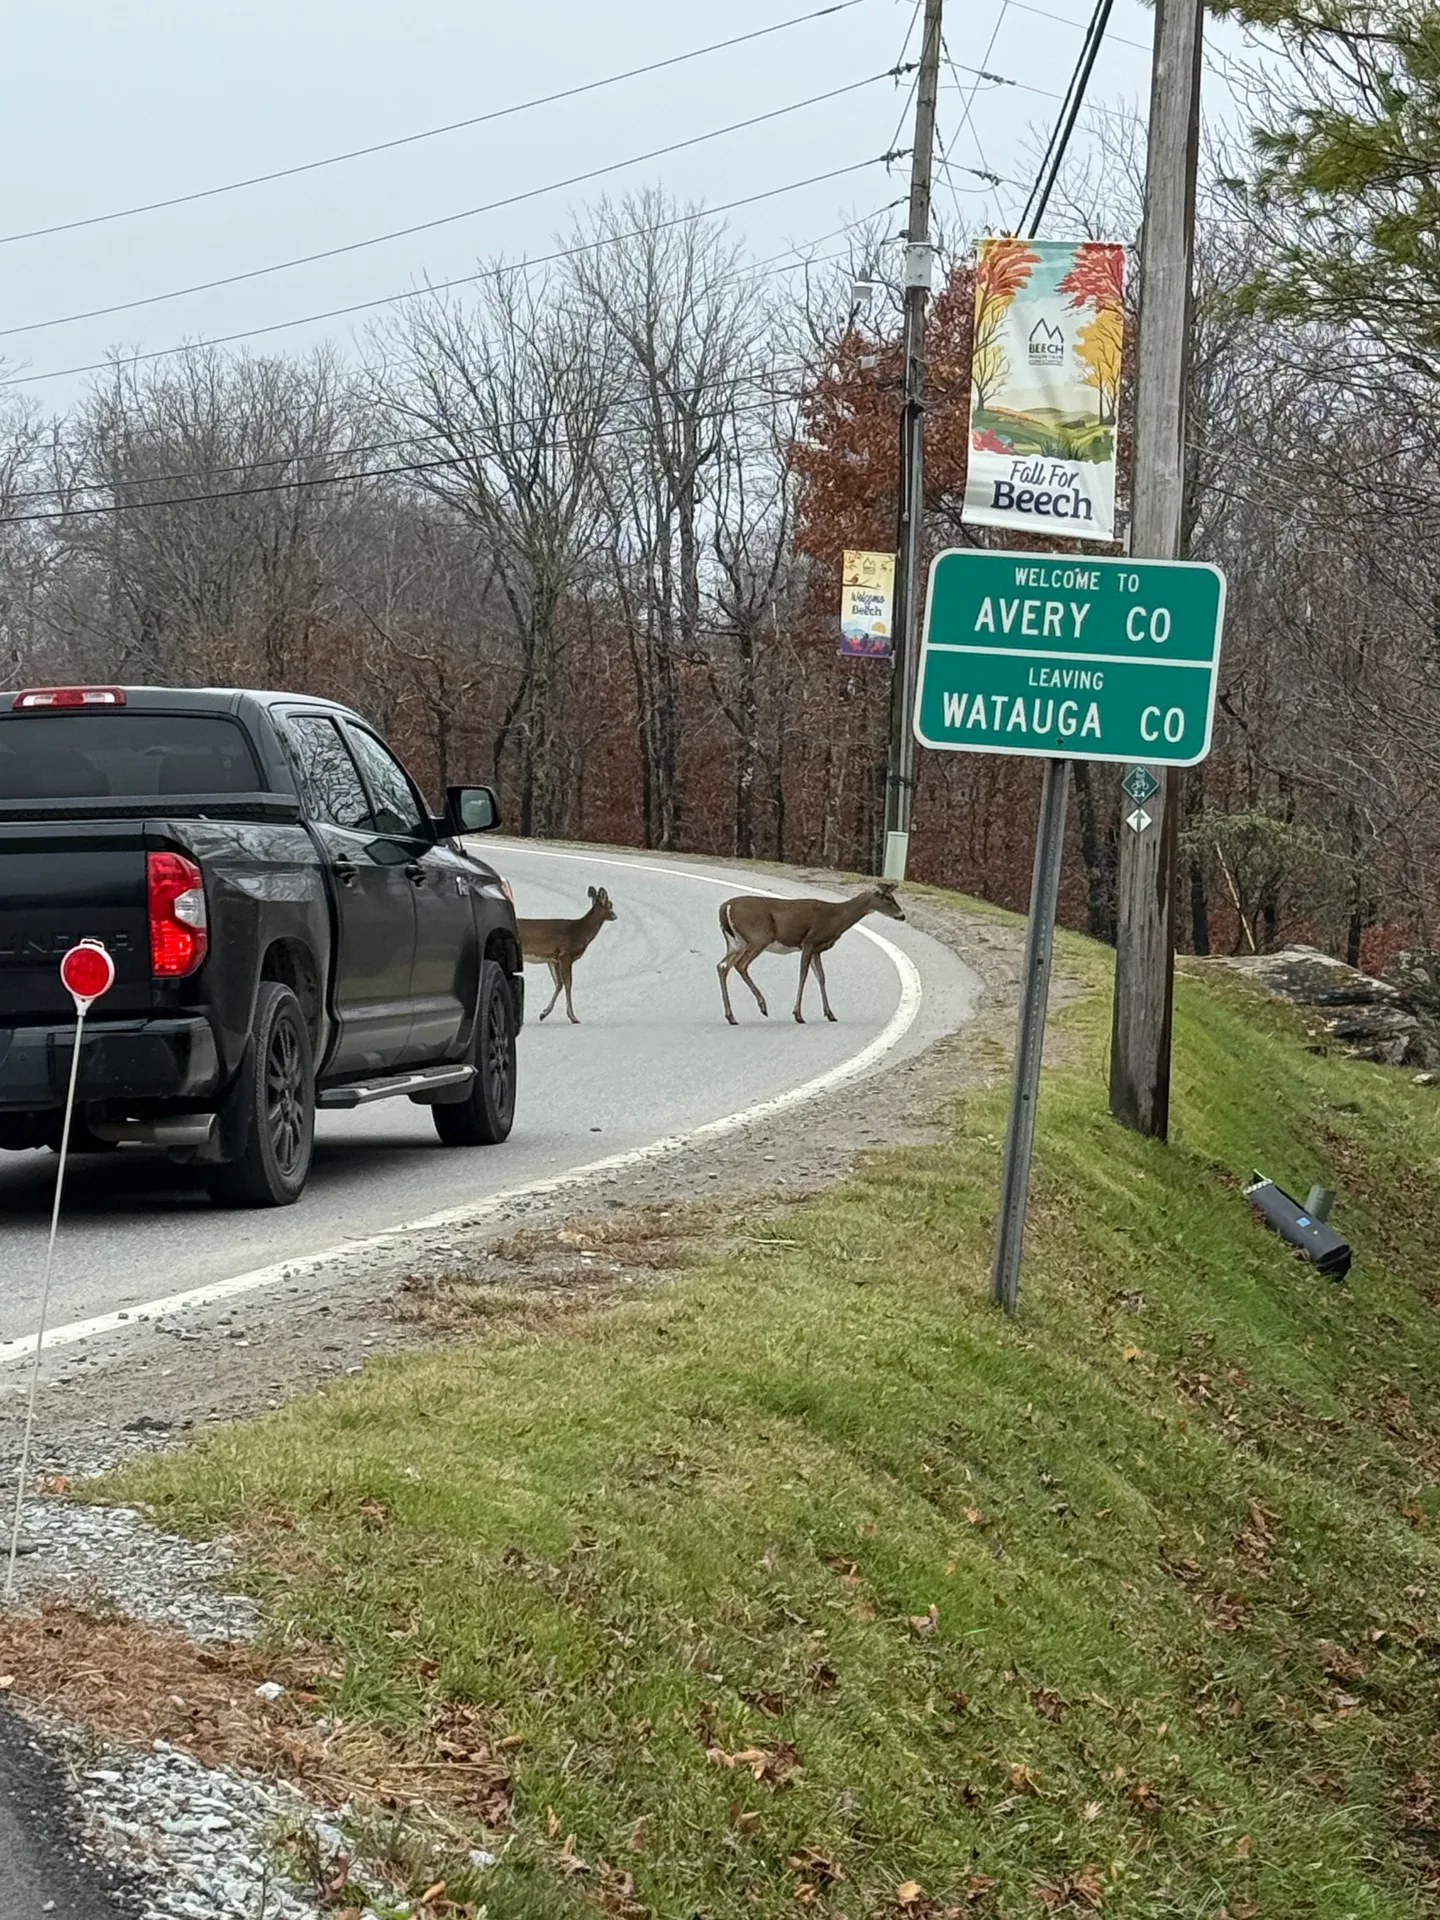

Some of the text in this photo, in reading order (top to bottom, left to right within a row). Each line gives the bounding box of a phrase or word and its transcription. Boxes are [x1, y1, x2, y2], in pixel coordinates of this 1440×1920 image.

[1029, 343, 1064, 354] BEECH
[1010, 460, 1080, 489] Fall For
[990, 480, 1093, 520] Beech
[1015, 567, 1140, 593] WELCOME TO
[974, 596, 1172, 643] AVERY CO
[1028, 667, 1104, 690] LEAVING
[943, 692, 1185, 743] WATAUGA CO
